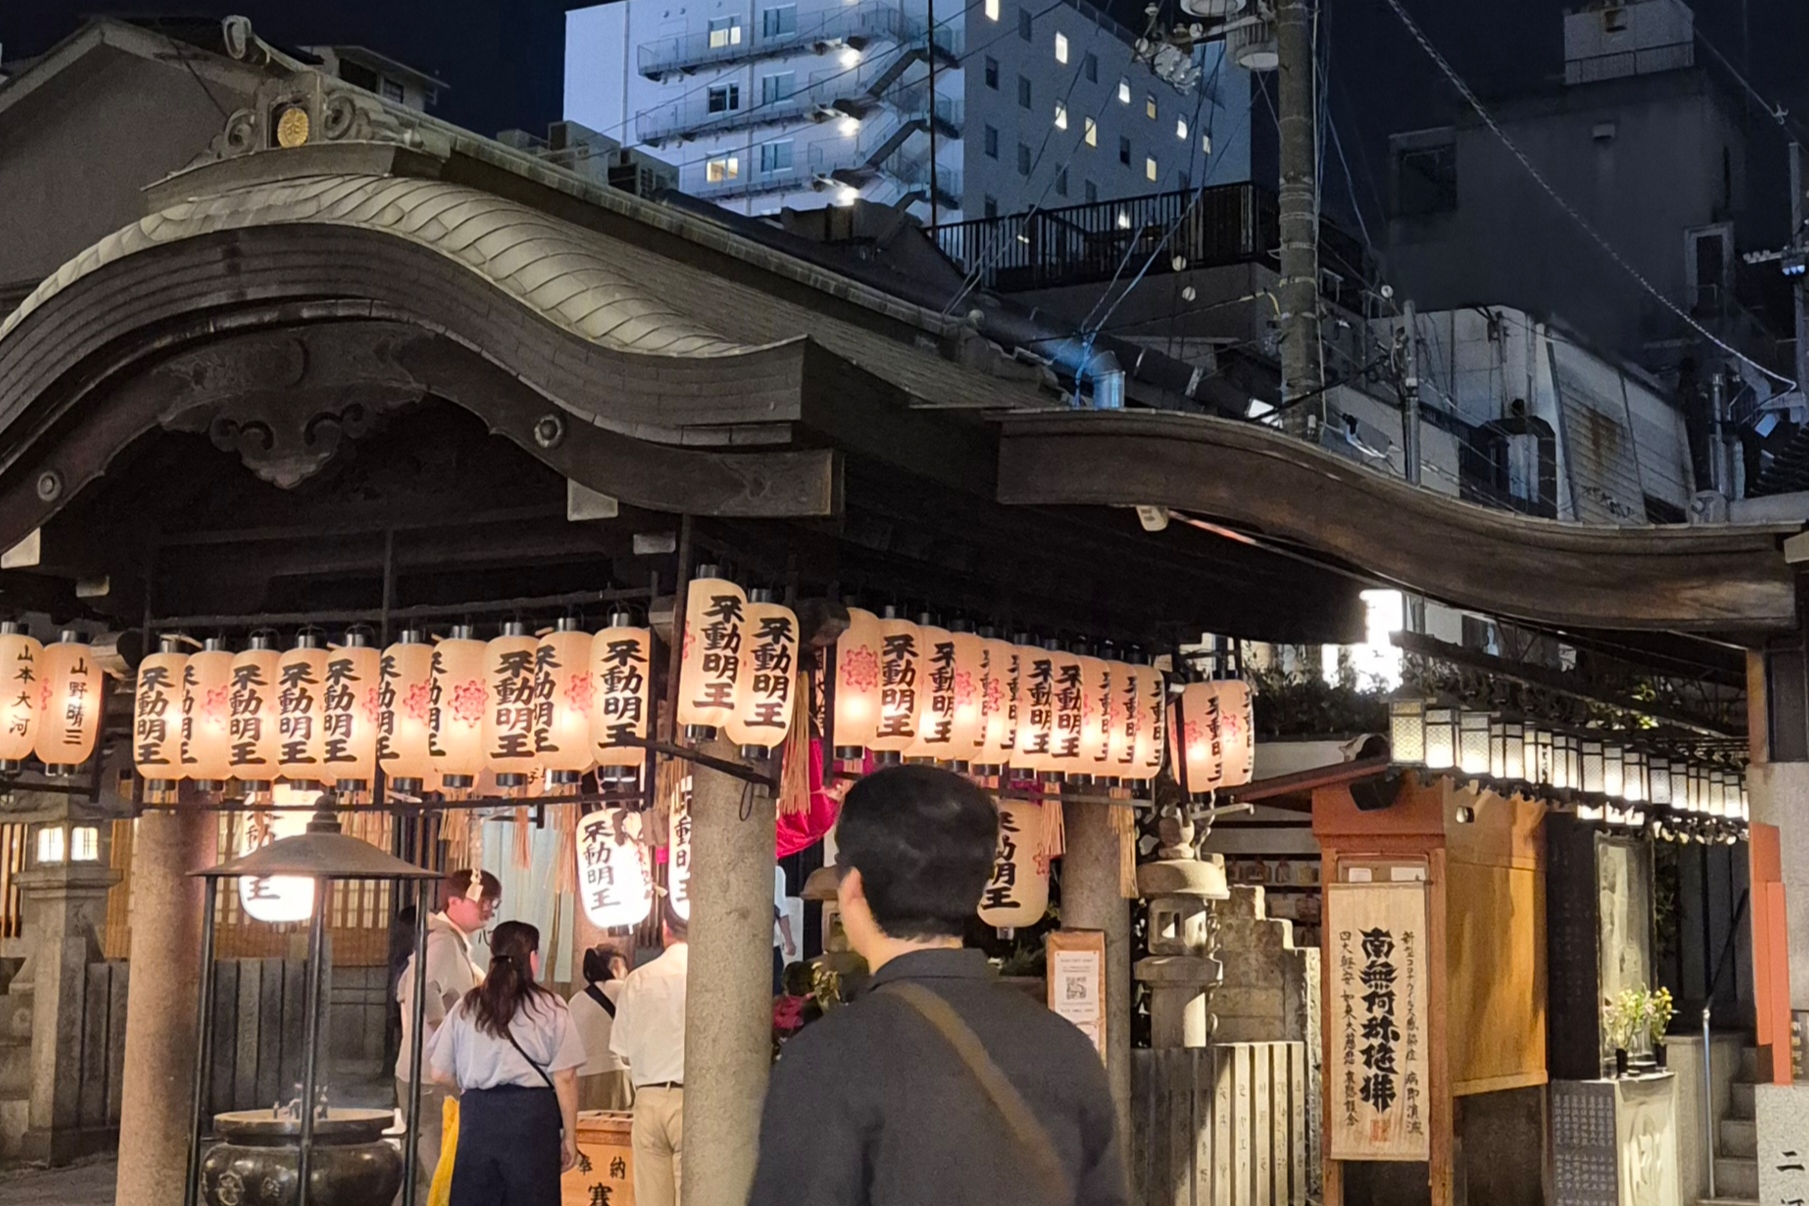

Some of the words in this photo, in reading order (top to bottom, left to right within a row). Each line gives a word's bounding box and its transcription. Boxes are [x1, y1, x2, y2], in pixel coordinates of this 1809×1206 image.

[9, 644, 36, 737] 山本大河
[490, 650, 535, 759] 不動明王
[598, 639, 648, 748] 不動明王
[692, 595, 745, 710] 不動明王
[744, 617, 795, 729] 不動明王
[876, 634, 919, 738] 不動明王
[136, 666, 176, 765] 不動明王
[228, 664, 269, 766] 不動明王
[277, 662, 319, 765] 不動明王
[323, 658, 361, 764] 不動明王
[582, 820, 621, 911] 不動明王
